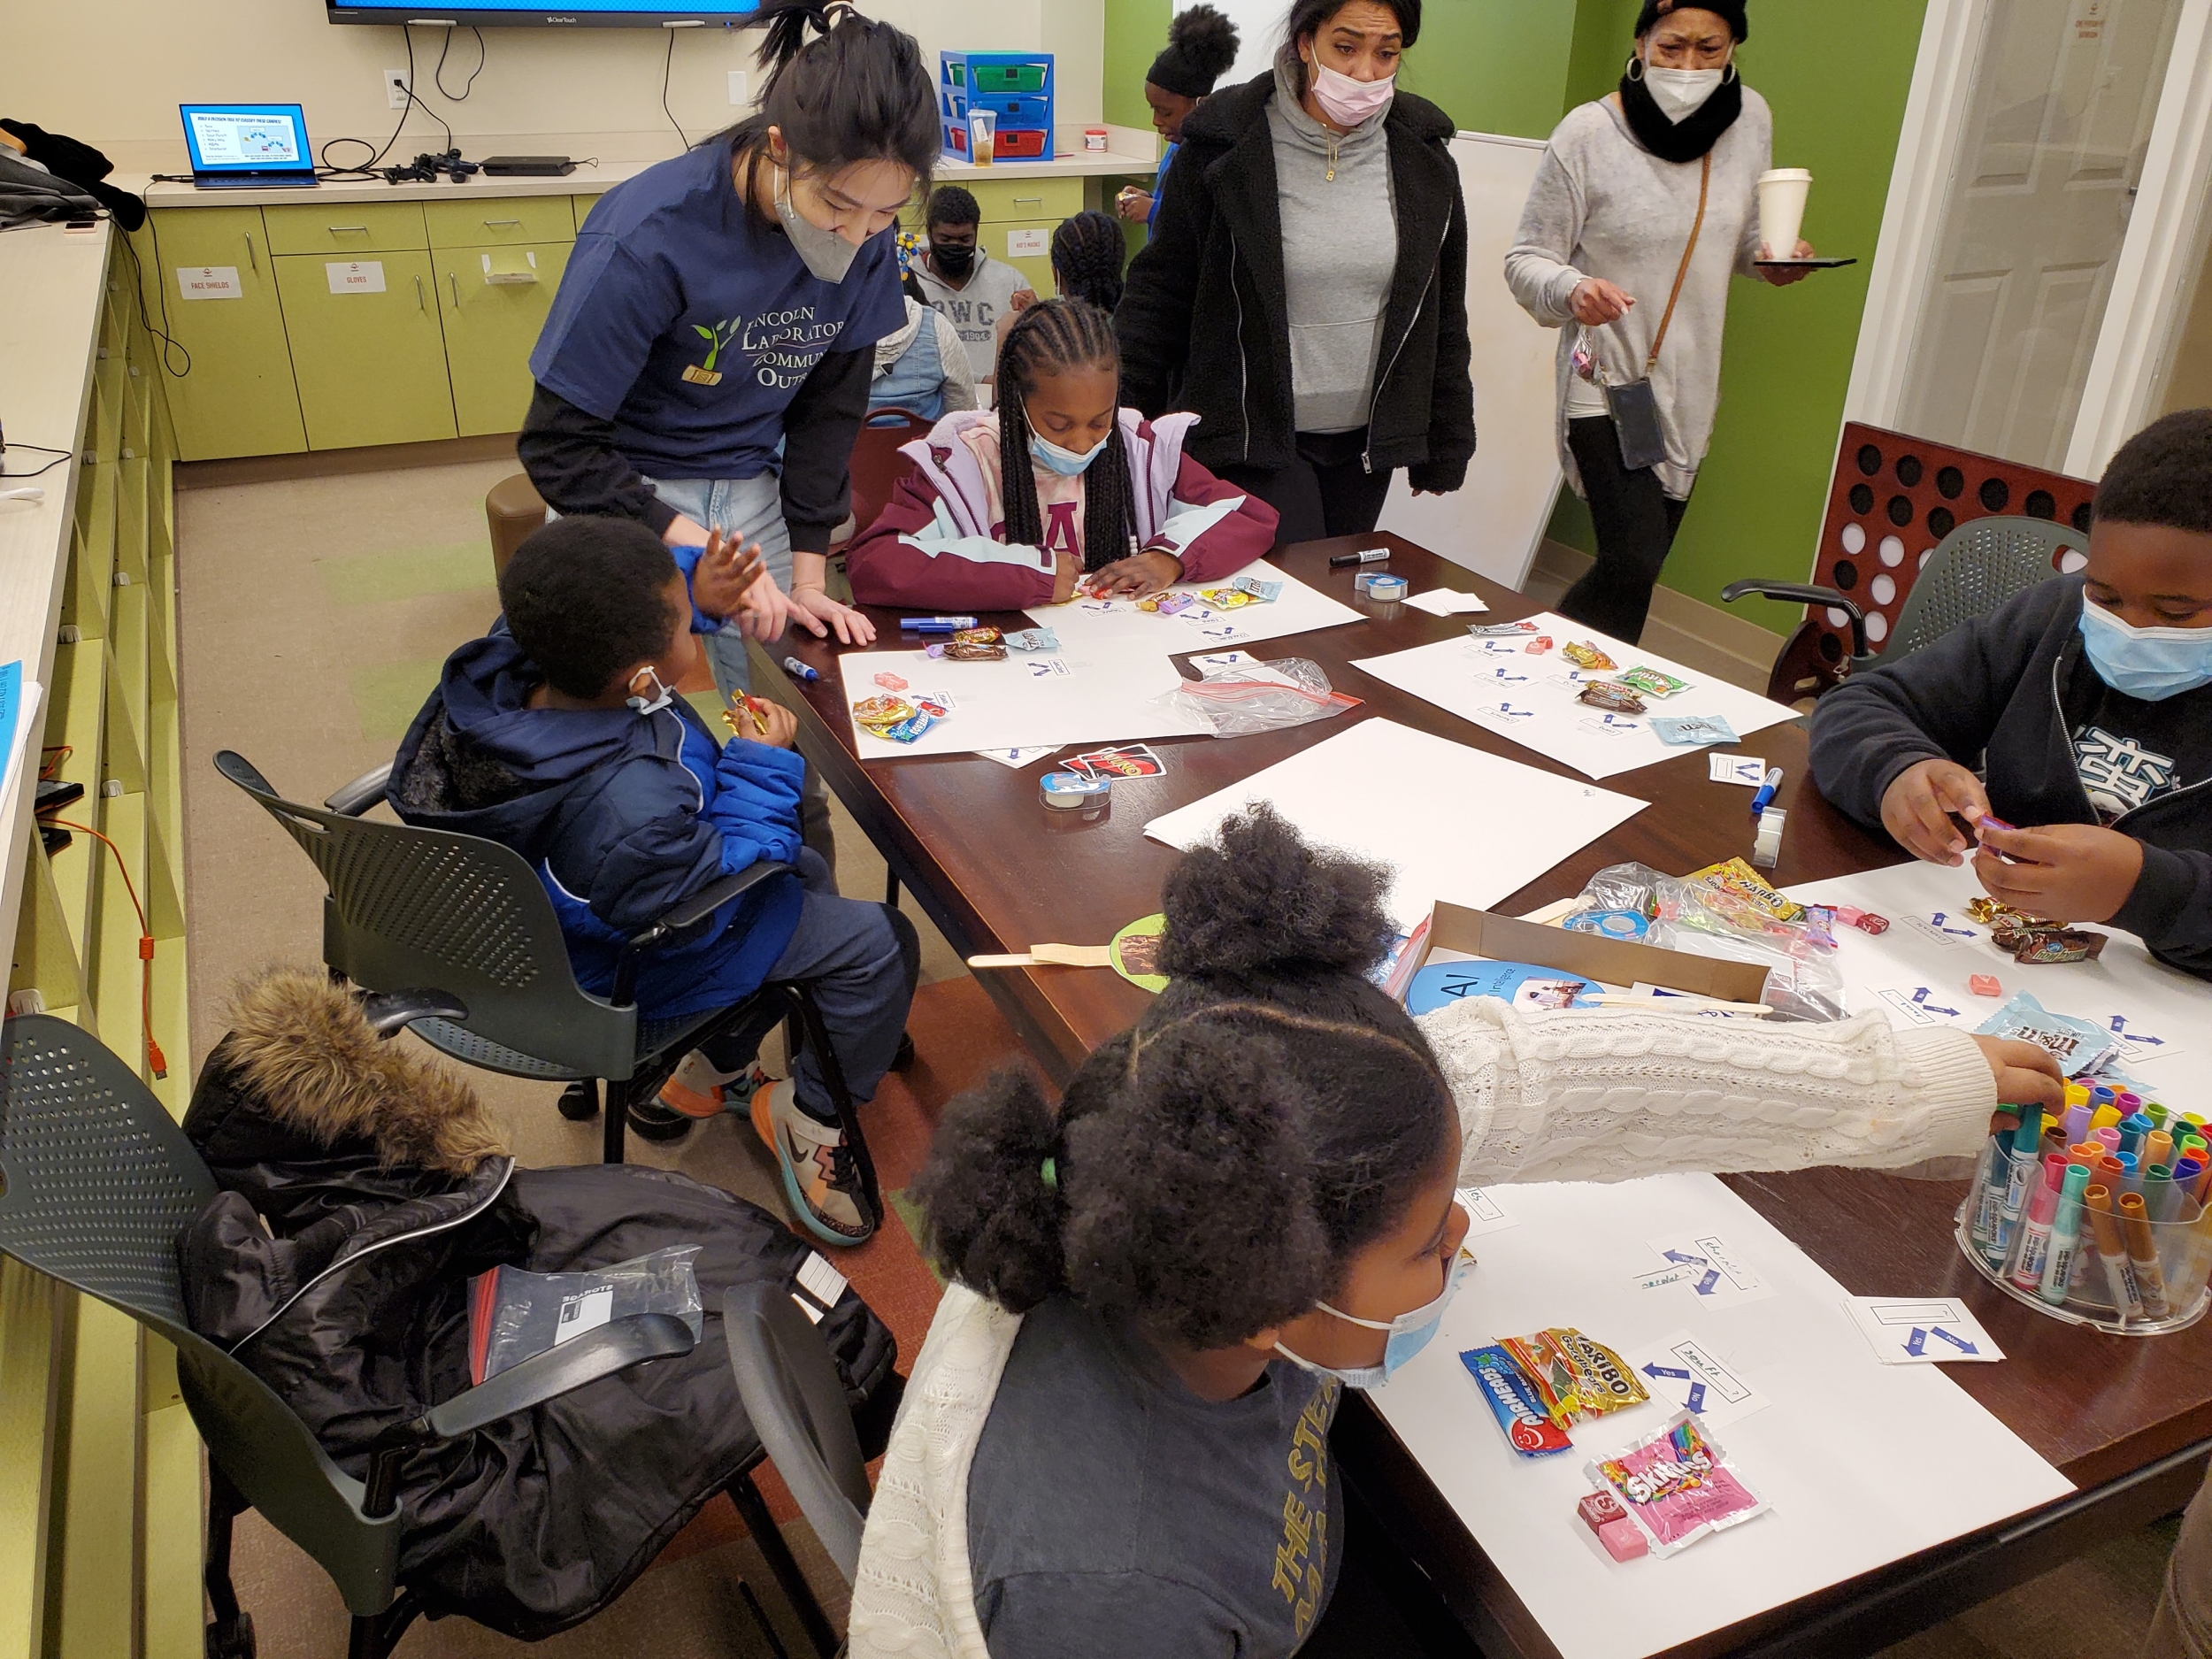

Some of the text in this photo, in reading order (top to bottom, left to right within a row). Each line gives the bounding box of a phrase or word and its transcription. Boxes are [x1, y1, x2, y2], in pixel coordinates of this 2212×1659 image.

[1913, 1336, 1924, 1346] Yes
[1946, 1334, 1960, 1346] No
[1478, 1367, 1545, 1426] AIRHEADS
[1520, 1384, 1537, 1403] BLUE
[1691, 1392, 1701, 1402] No
[1626, 1450, 1715, 1506] Skittles
[1272, 1490, 1313, 1603] THE
